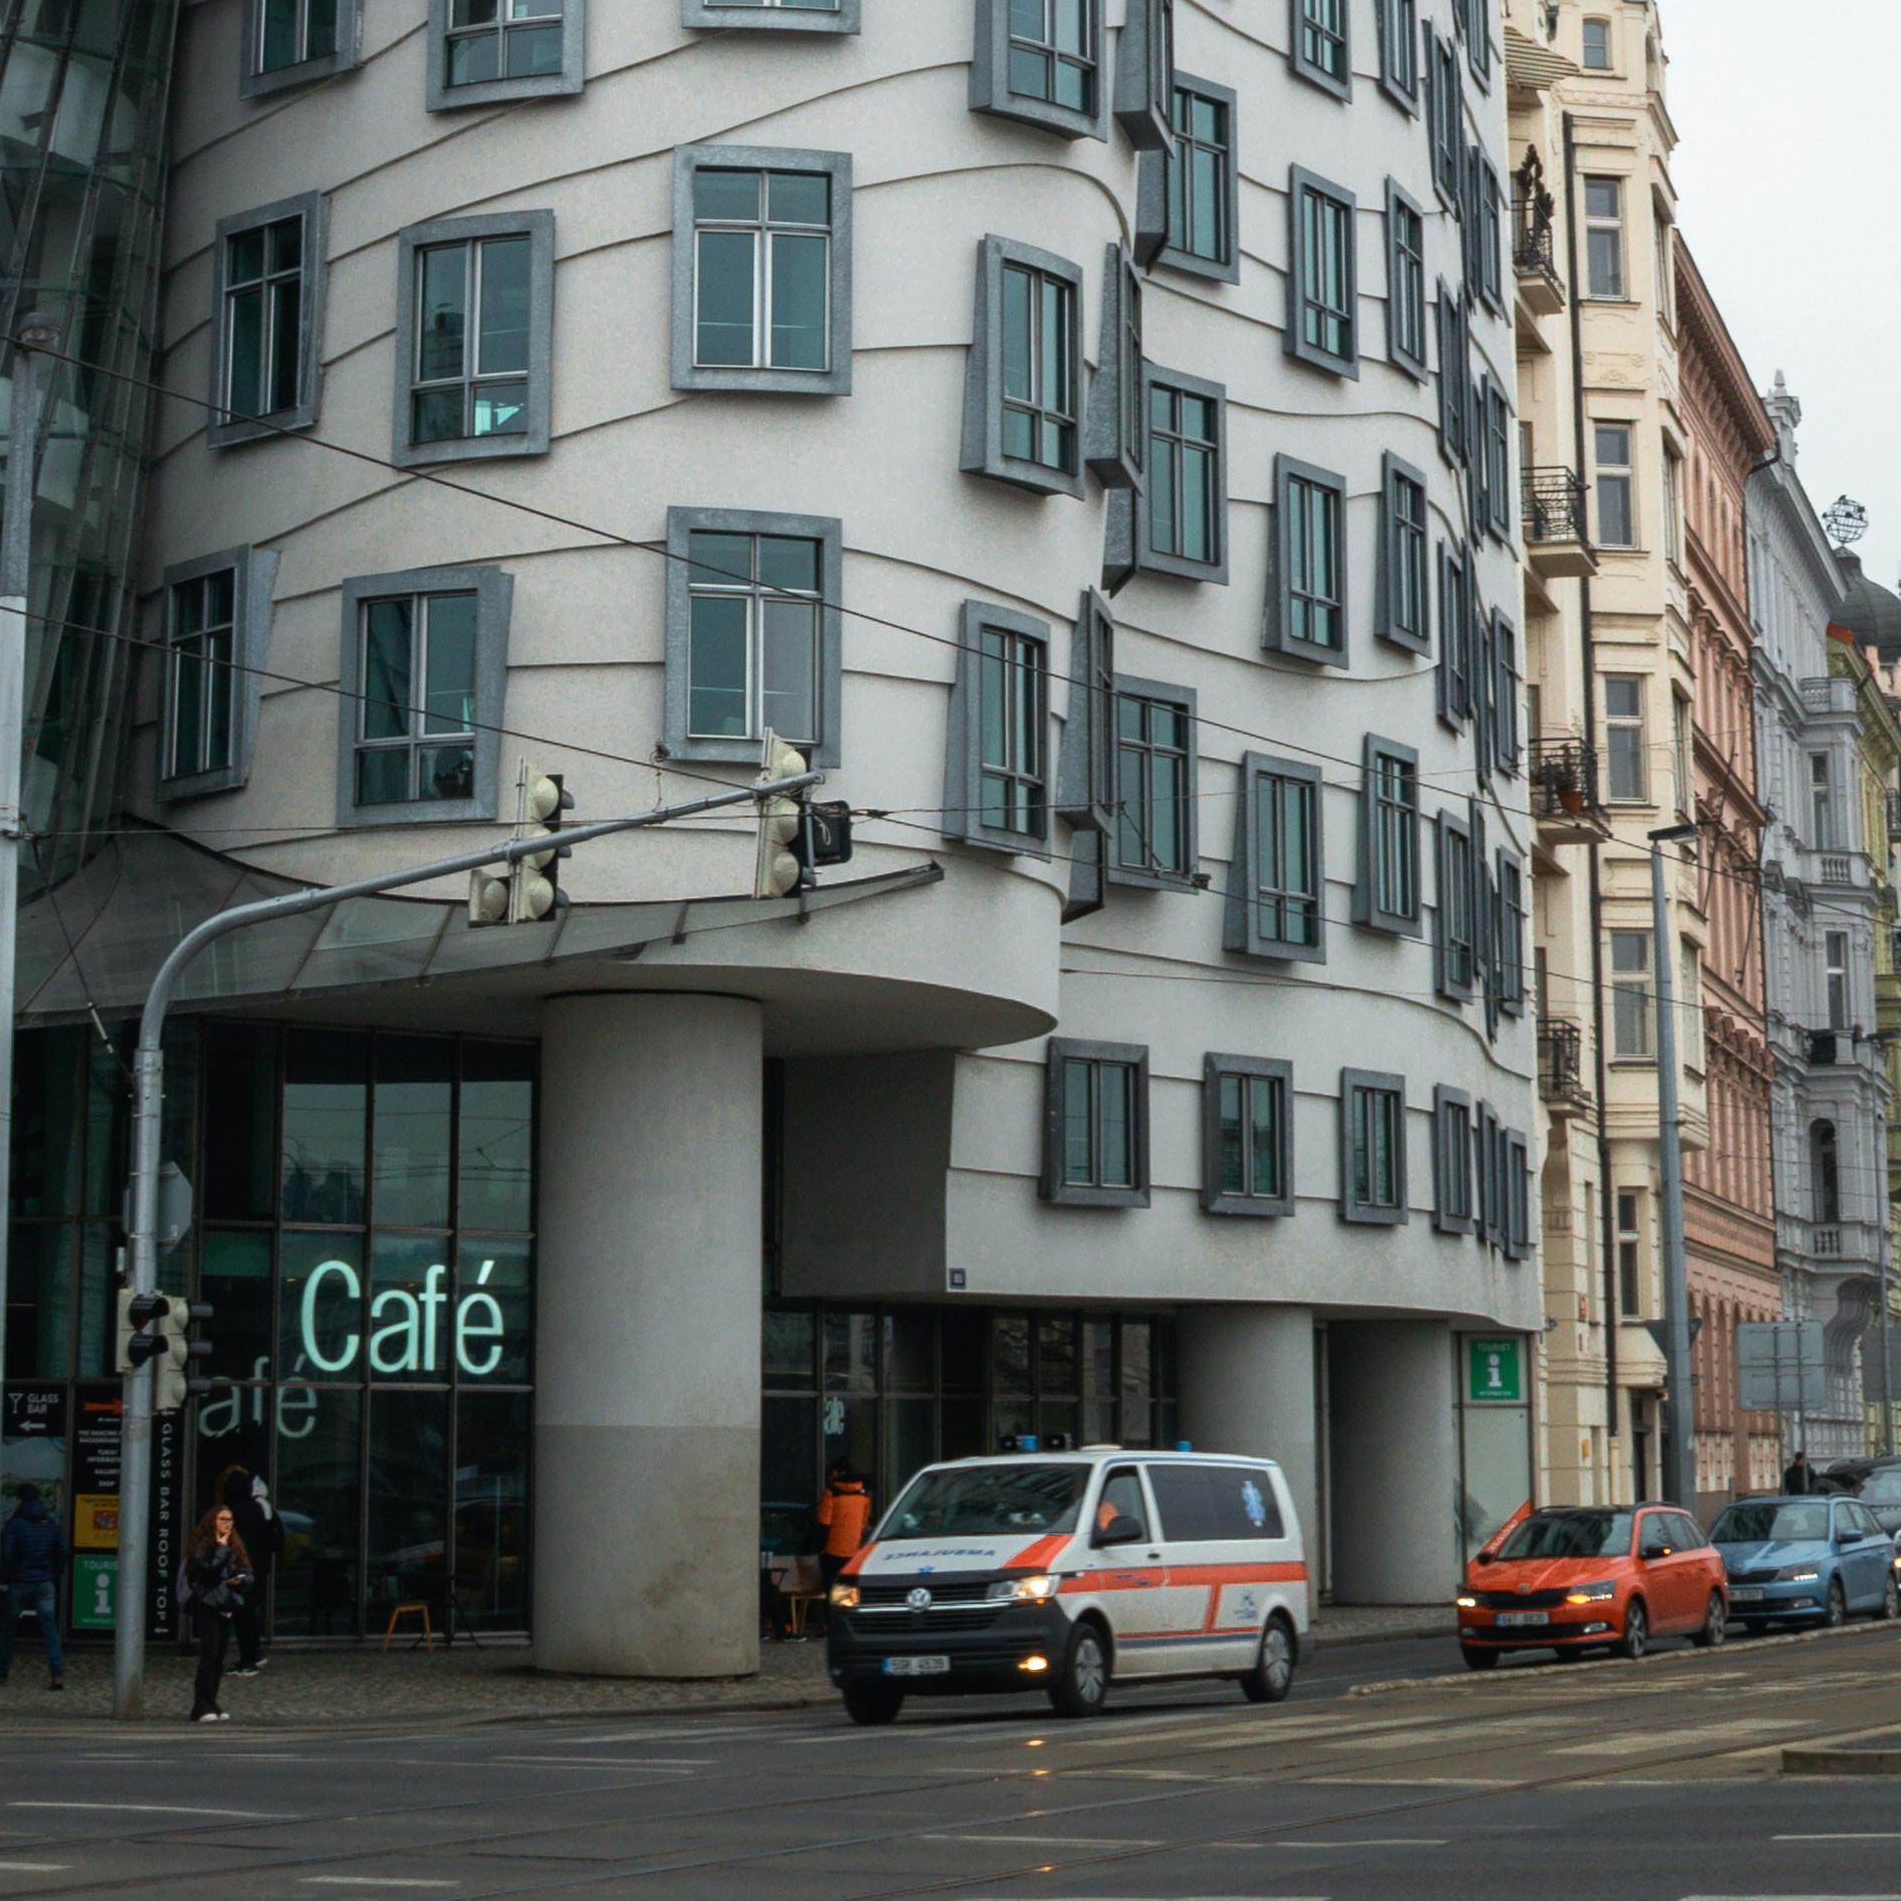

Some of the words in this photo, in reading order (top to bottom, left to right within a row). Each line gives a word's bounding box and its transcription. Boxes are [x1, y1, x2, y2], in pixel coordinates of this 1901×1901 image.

[301, 1259, 504, 1375] Café
[27, 1393, 59, 1404] GLASS
[27, 1404, 48, 1415] BAR
[161, 1422, 174, 1479] GLASS
[159, 1486, 171, 1521] BAR
[83, 1559, 119, 1571] TOURIS
[157, 1528, 170, 1578] ROOF
[156, 1585, 168, 1621] TOP
